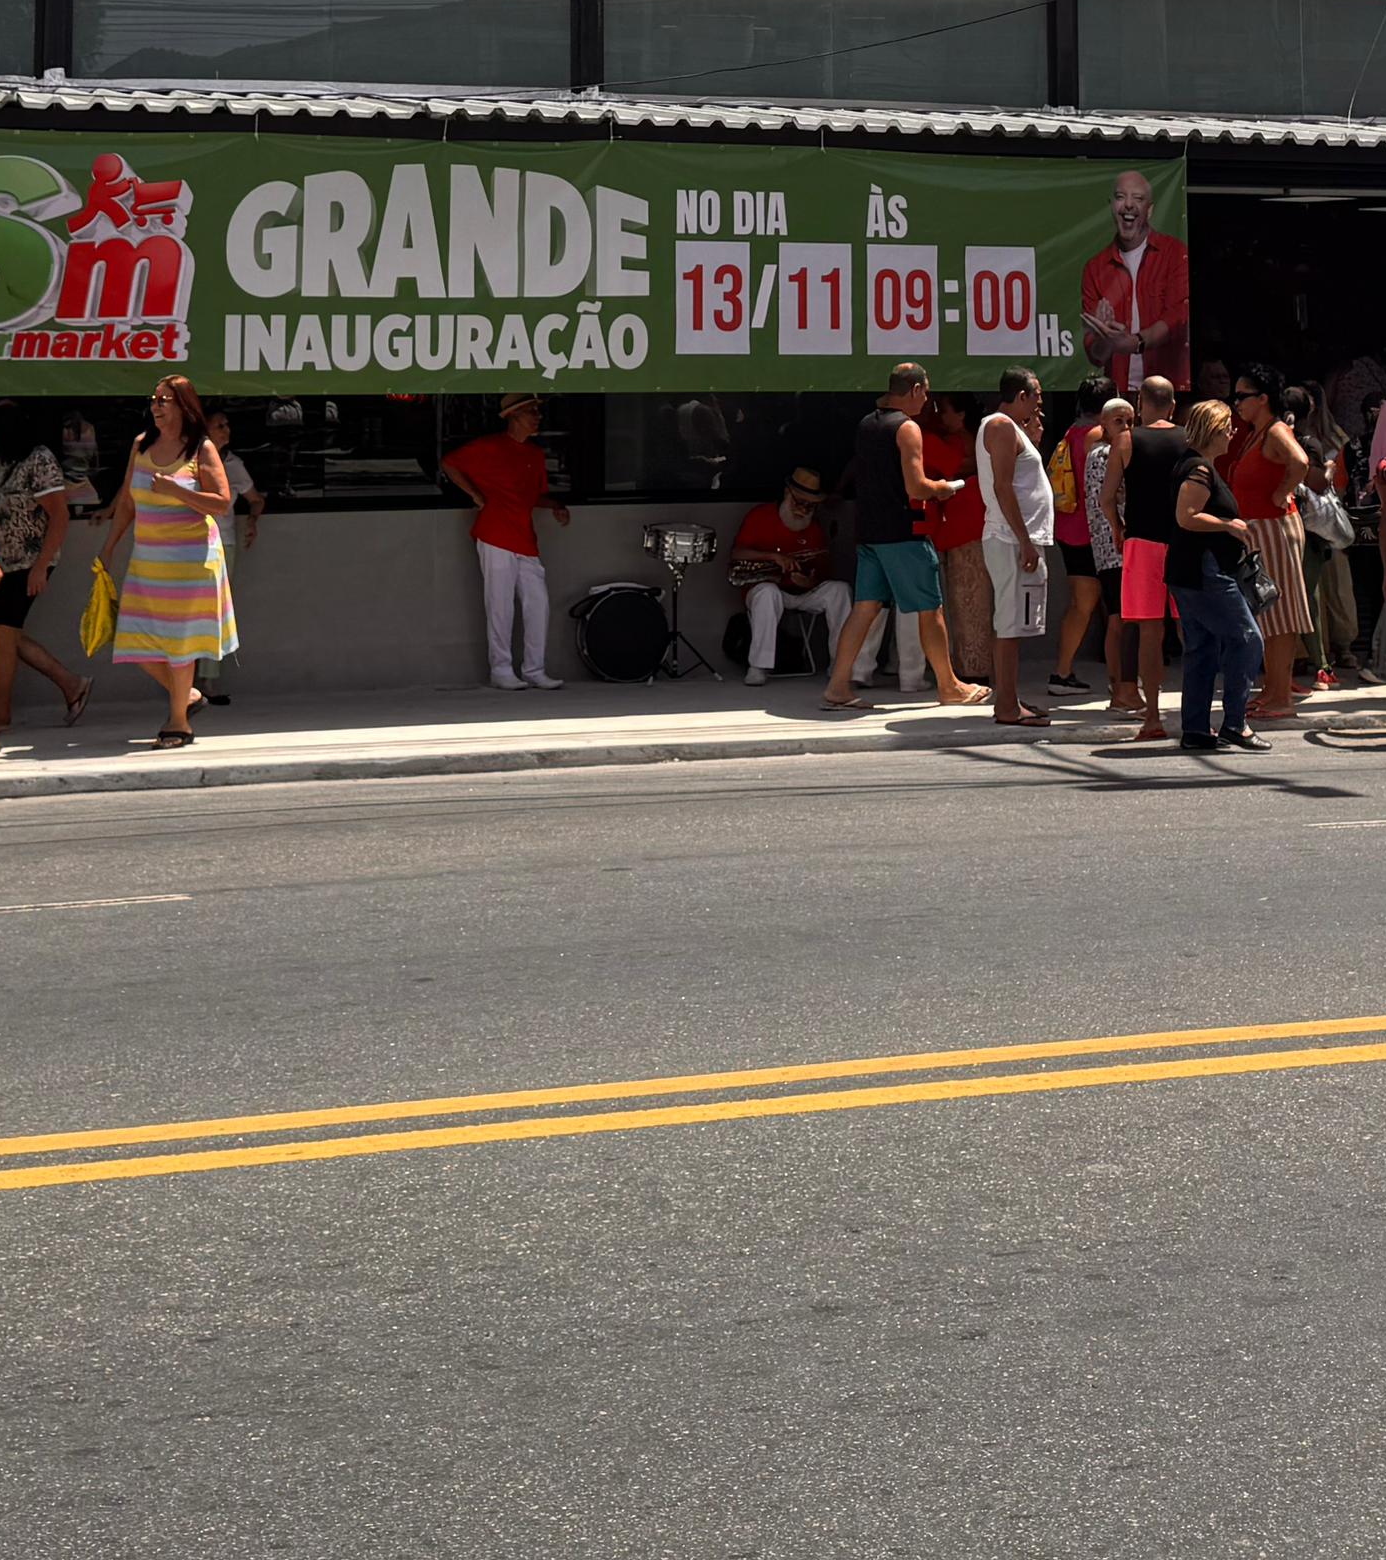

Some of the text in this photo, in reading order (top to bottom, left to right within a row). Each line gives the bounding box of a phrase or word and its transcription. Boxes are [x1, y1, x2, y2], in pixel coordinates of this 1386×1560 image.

[226, 163, 650, 299] GRANDE
[676, 189, 788, 237] NO DIA
[866, 183, 908, 239] ÀS
[224, 301, 649, 380] INAUGURAÇÃO
